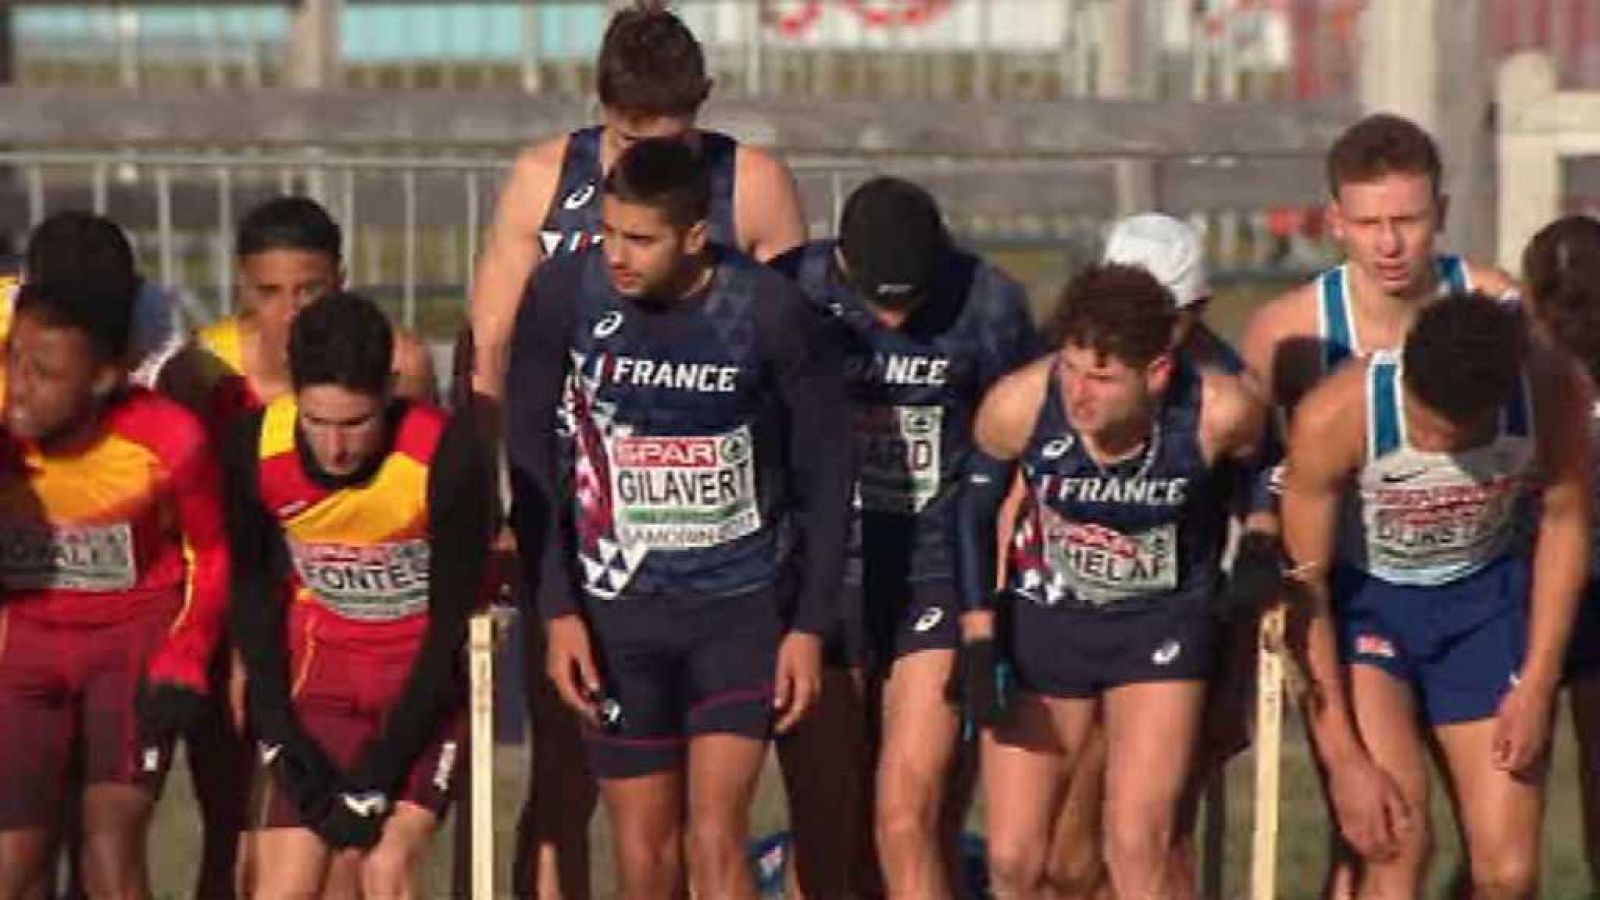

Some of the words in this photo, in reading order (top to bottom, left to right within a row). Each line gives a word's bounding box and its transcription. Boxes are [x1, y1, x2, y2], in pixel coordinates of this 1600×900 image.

[612, 356, 738, 393] FRANCE
[615, 440, 716, 467] SPAR
[617, 461, 749, 505] GILAVERT
[1059, 477, 1189, 506] FRANCE
